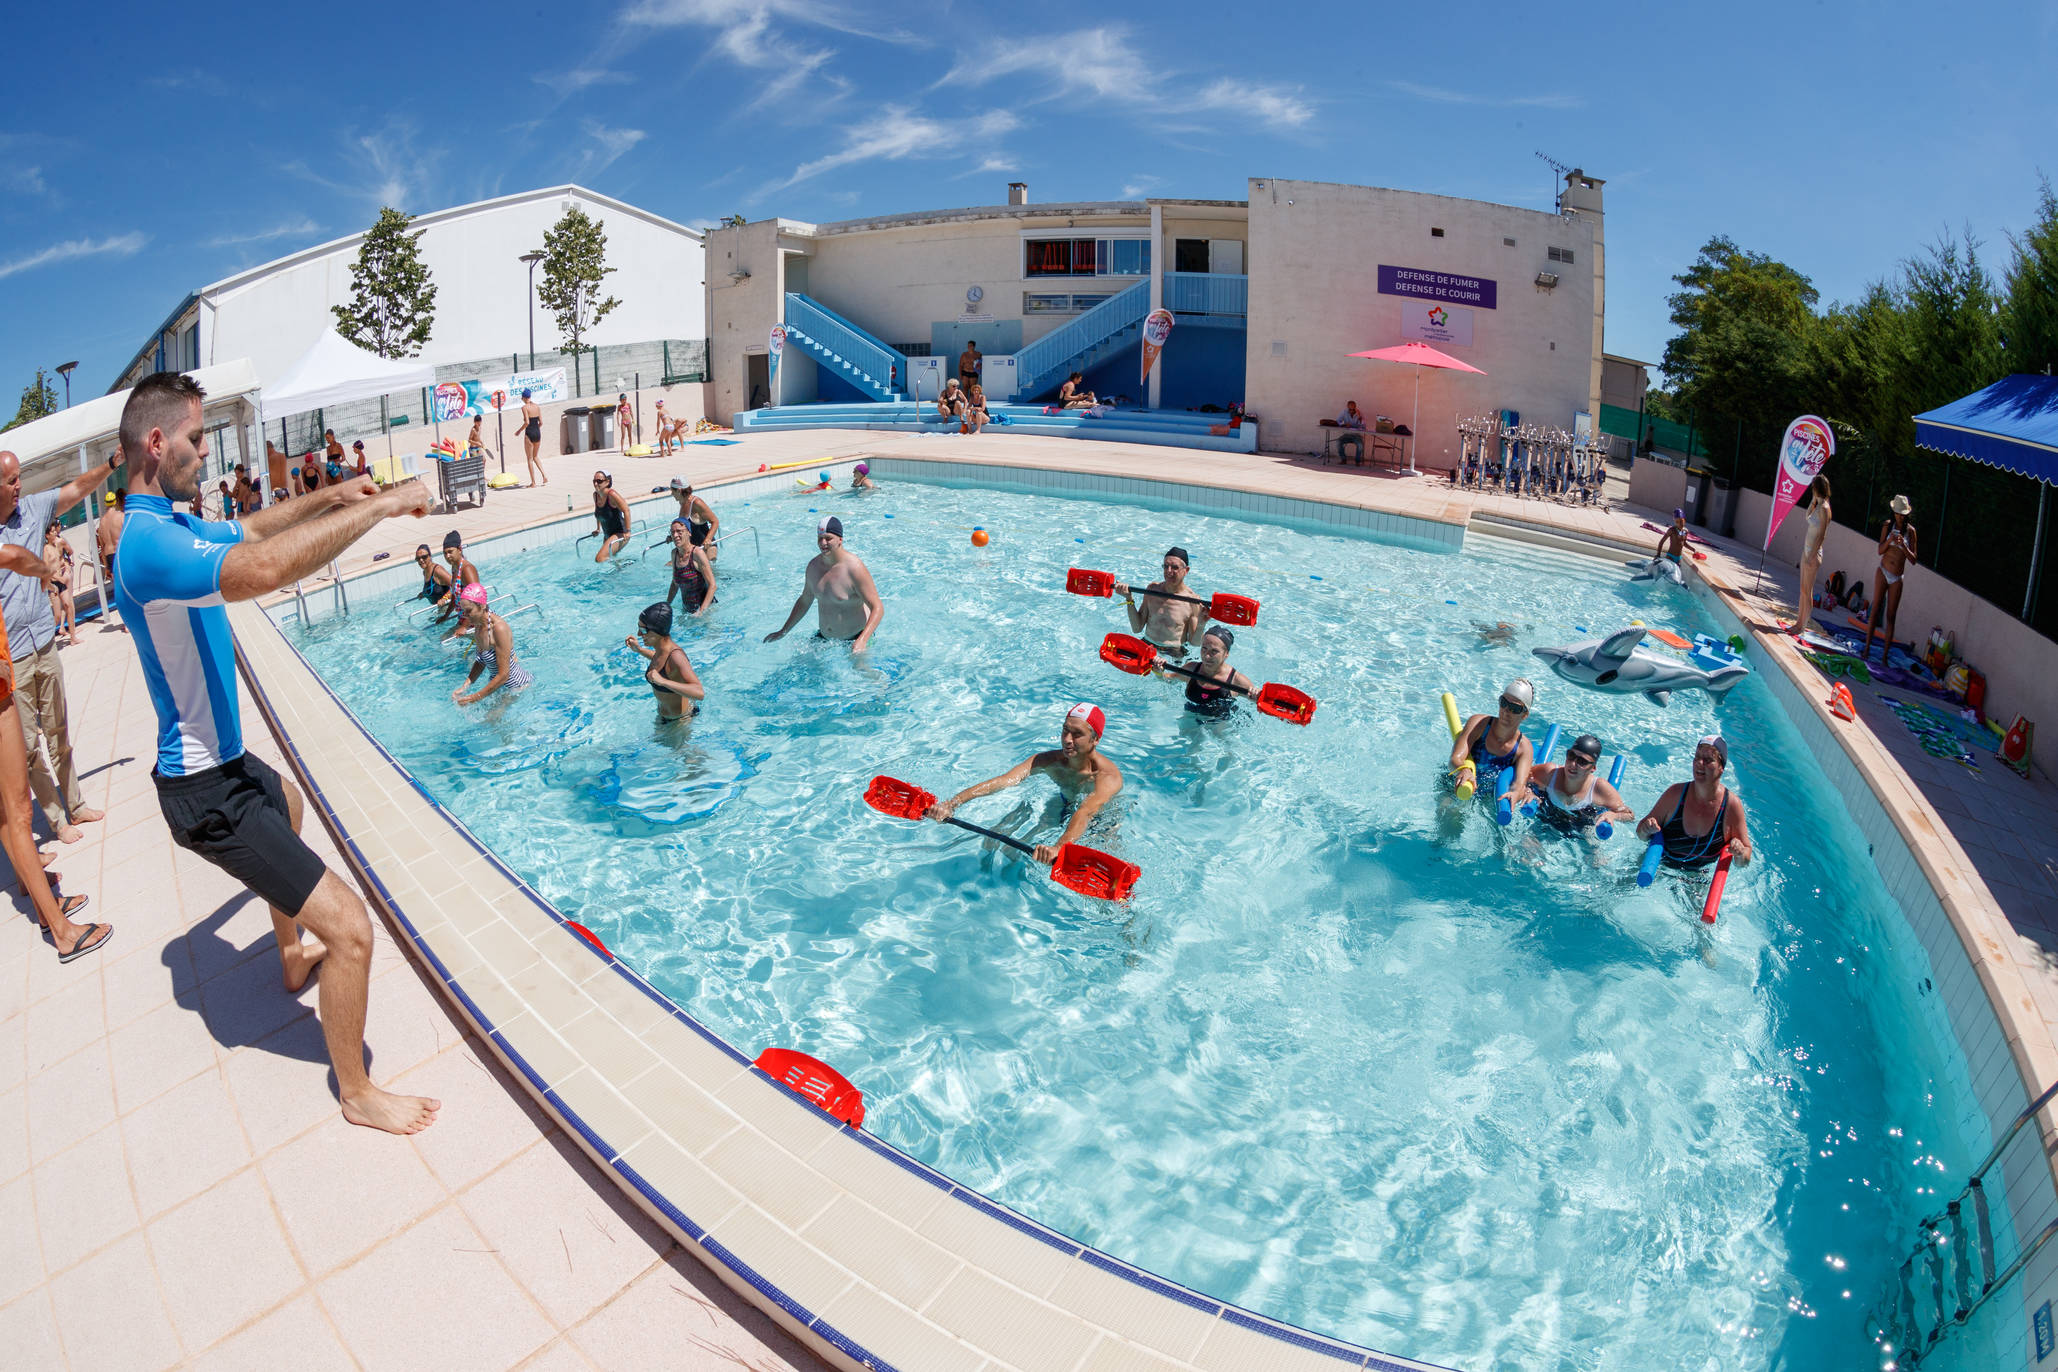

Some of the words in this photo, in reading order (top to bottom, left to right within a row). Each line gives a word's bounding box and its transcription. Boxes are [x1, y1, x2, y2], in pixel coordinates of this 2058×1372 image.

[1397, 270, 1435, 283] DEFENSE
[1437, 275, 1448, 285] DE
[1450, 277, 1479, 289] FUMER
[1395, 282, 1434, 294] DEFENSE
[1435, 287, 1447, 296] DE
[1448, 289, 1480, 301] COURIR
[510, 387, 522, 396] DES
[1793, 428, 1820, 443] PISCINES
